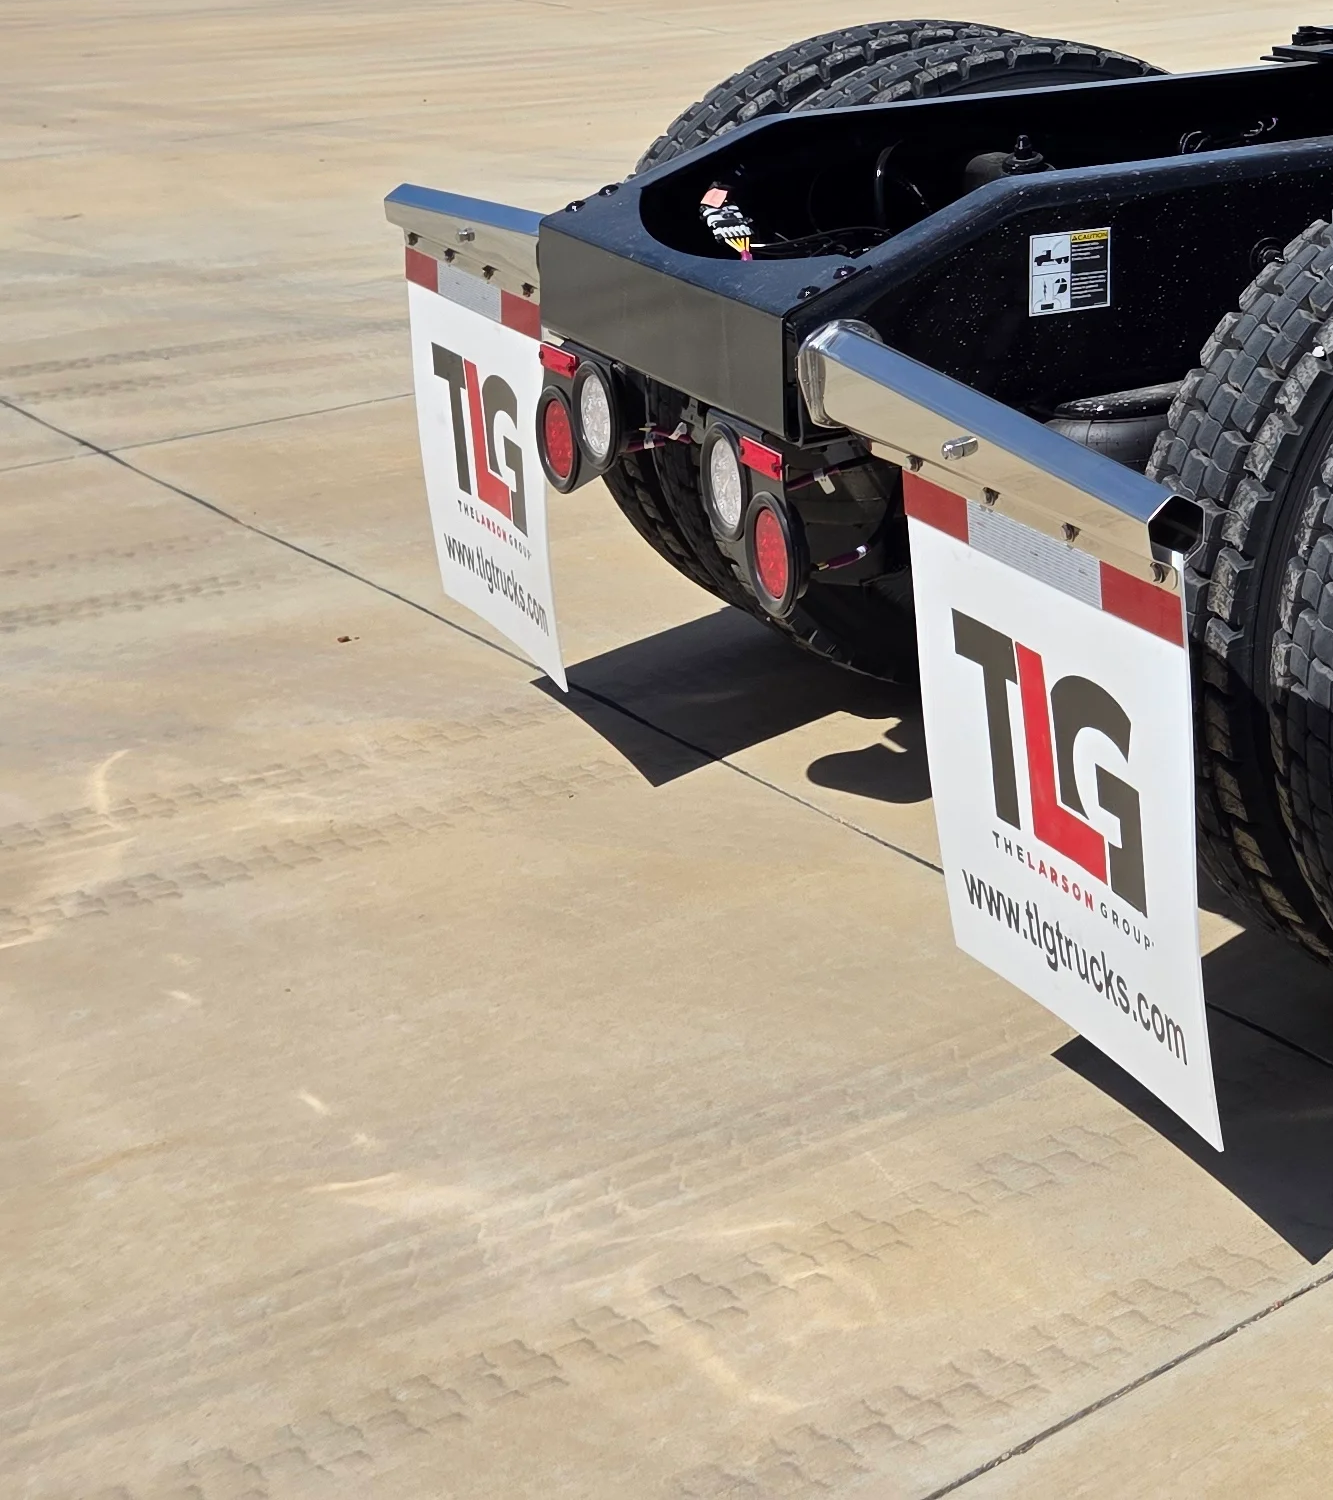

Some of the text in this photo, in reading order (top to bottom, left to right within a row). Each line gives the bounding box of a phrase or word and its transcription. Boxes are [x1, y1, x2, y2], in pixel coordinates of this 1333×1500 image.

[1077, 231, 1108, 241] CAUTION
[431, 341, 529, 538] TLG
[443, 532, 550, 637] www.tlgtrucks.com
[509, 534, 532, 561] GROUP
[950, 607, 1148, 919] TLG
[961, 868, 1188, 1067] www.tlgtrucks.com
[1099, 901, 1152, 950] GROUP
